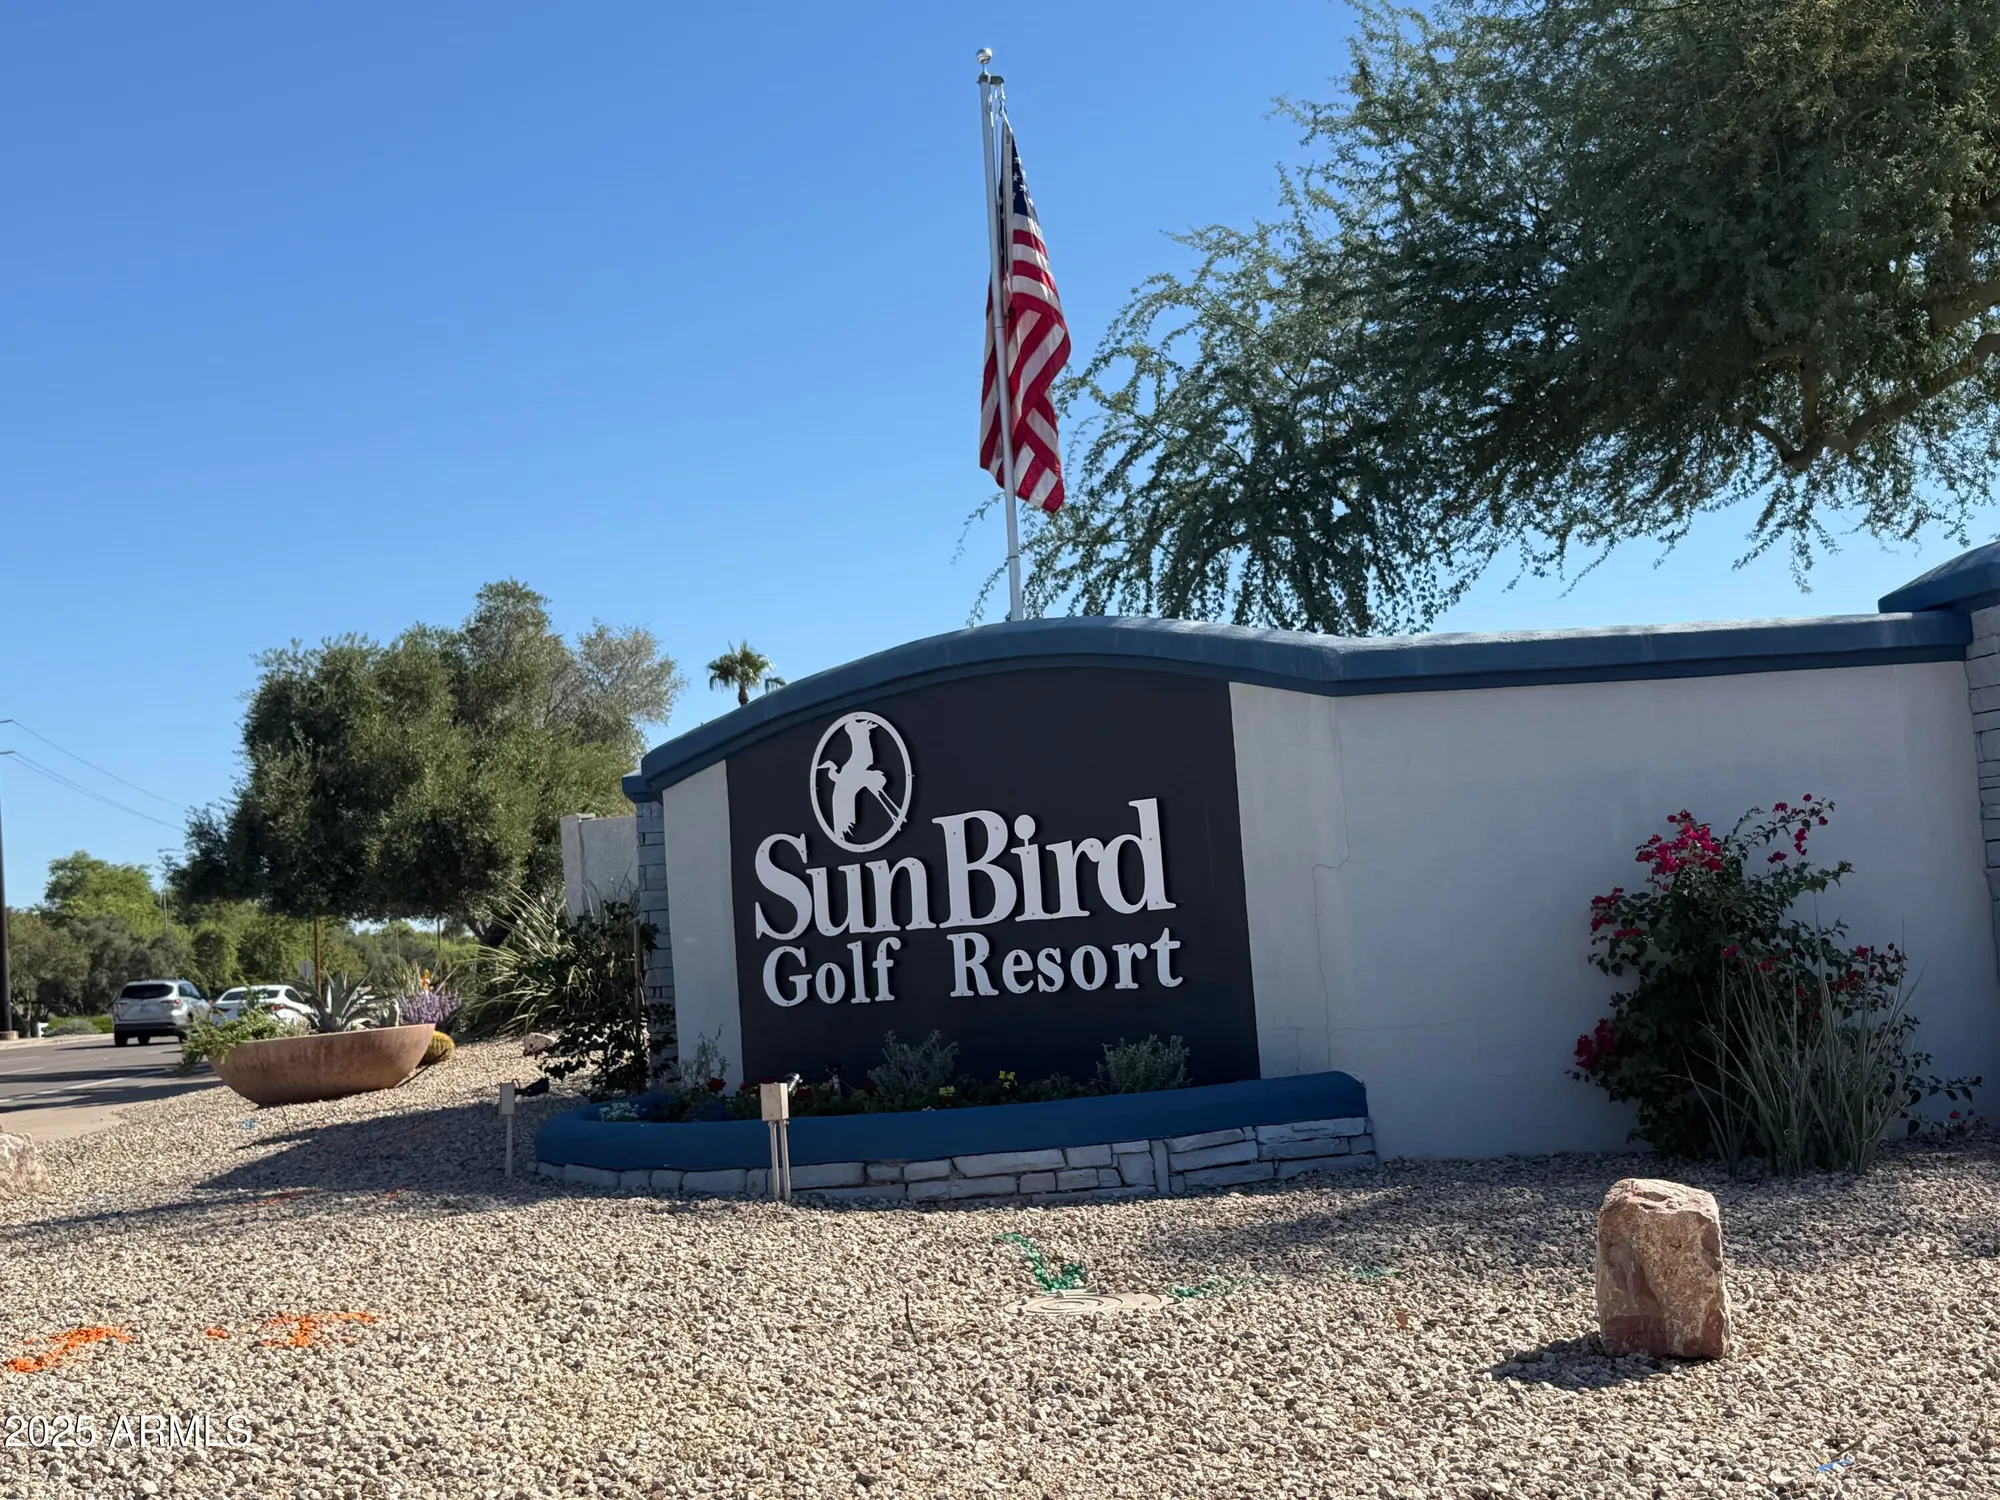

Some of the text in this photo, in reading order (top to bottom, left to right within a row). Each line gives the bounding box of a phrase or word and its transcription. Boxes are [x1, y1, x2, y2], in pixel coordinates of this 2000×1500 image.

[754, 798, 1177, 940] SunBird
[762, 927, 1184, 1007] Golf Resort
